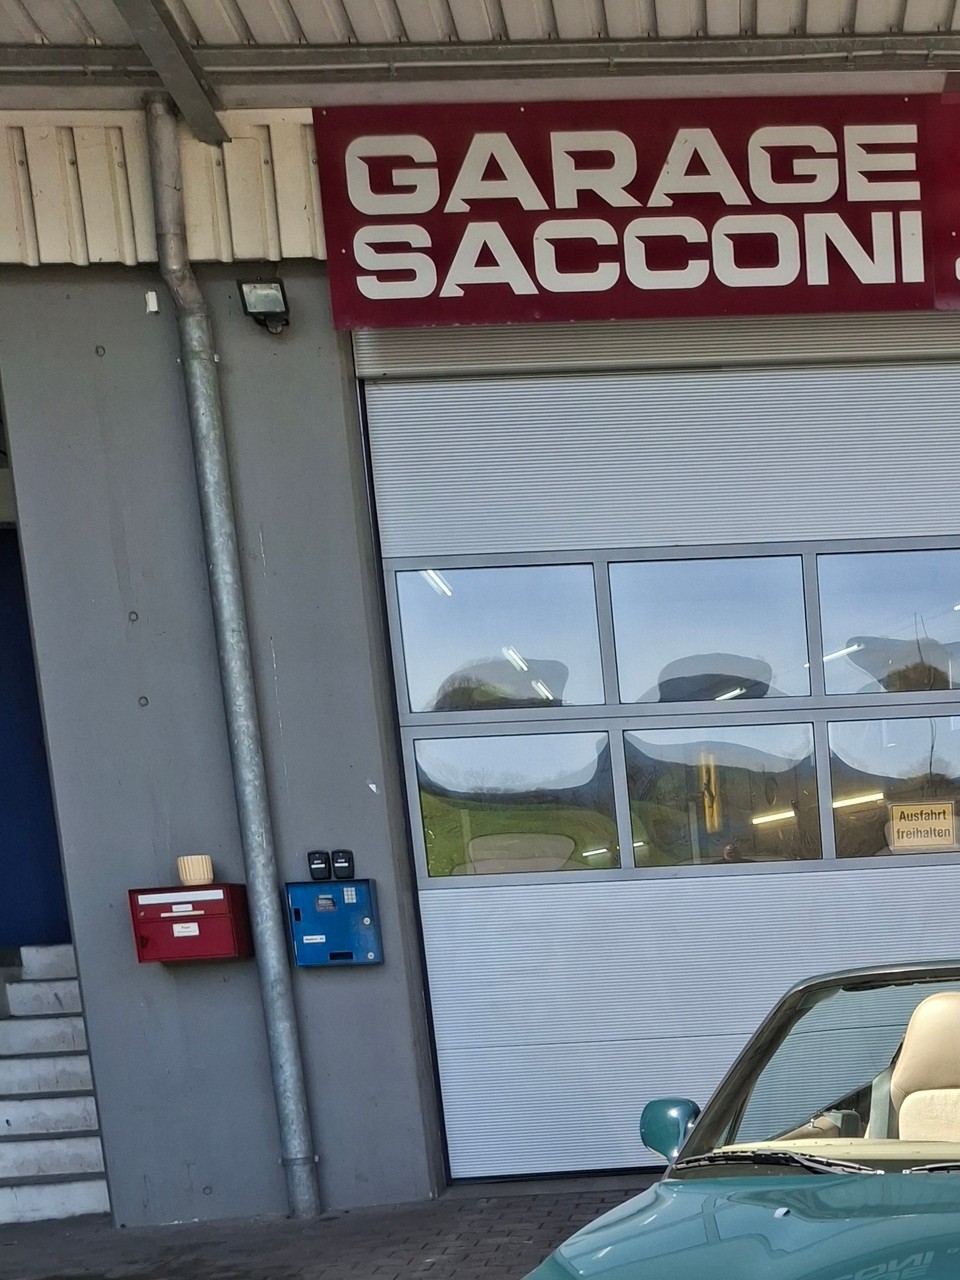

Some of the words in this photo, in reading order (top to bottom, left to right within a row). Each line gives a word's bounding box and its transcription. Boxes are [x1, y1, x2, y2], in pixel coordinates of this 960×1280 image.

[345, 124, 921, 216] GARAGE
[352, 211, 925, 300] SACCONI
[896, 826, 951, 840] freihalten
[898, 808, 947, 822] Ausfahrt
